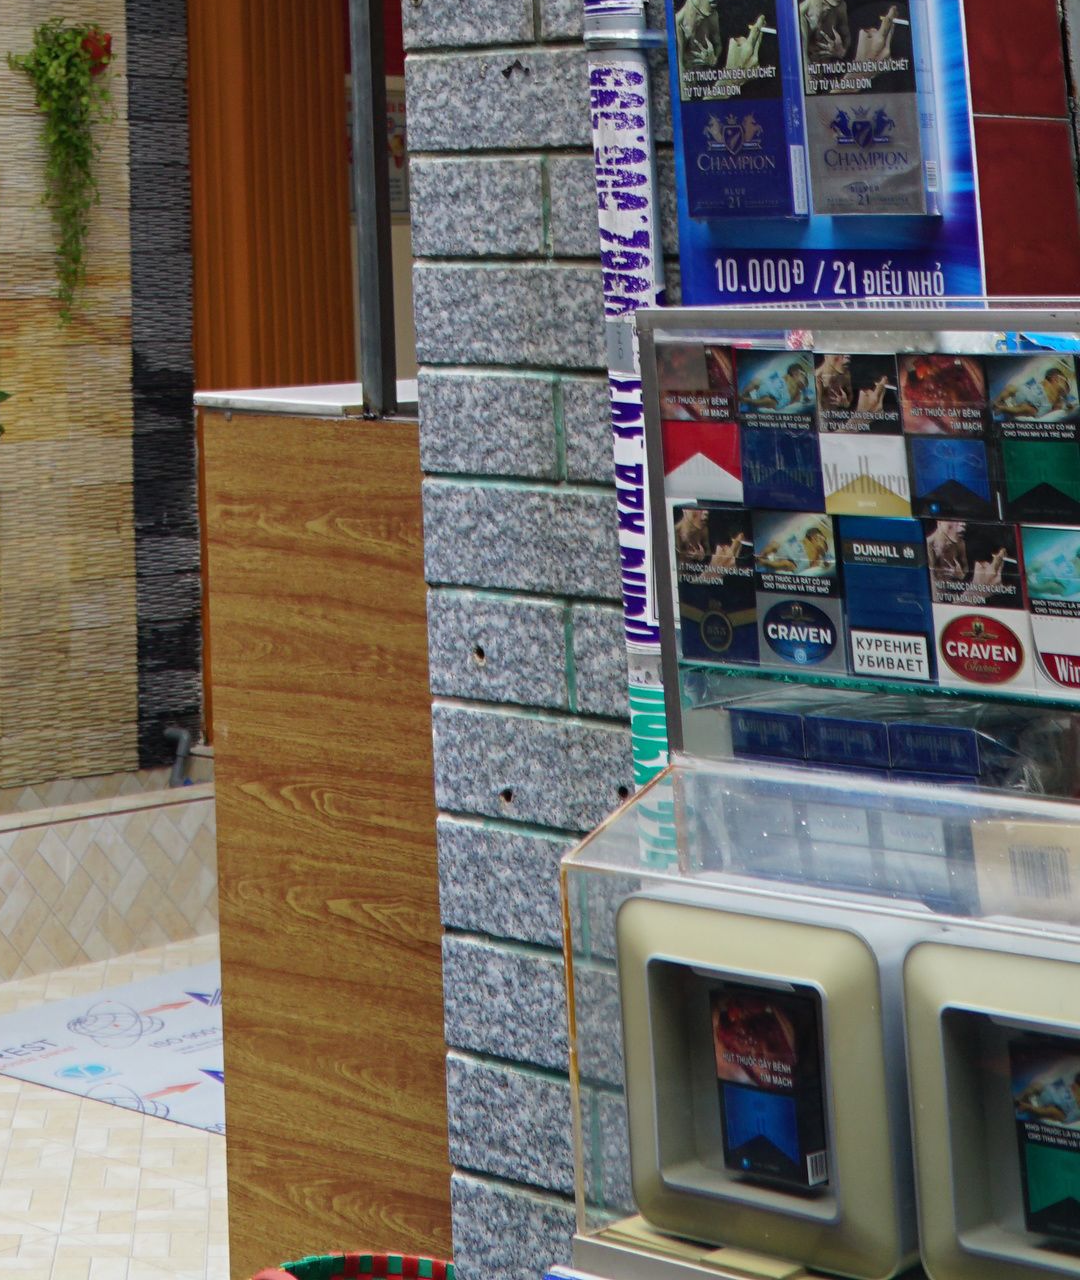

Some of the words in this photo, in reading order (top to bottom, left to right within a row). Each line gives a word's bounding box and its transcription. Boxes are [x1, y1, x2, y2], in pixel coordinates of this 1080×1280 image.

[697, 154, 776, 171] CHAMPION
[824, 149, 909, 167] CHAMPION
[833, 261, 857, 295] 21
[863, 260, 903, 296] ĐIẾU
[907, 262, 944, 296] NHỎ
[852, 543, 899, 558] DUNHILL
[767, 624, 831, 645] CRAVEN
[856, 637, 923, 655] КУРЕНИЕ
[946, 641, 1017, 662] CRAVEN
[858, 654, 923, 672] УБИВАЕТ
